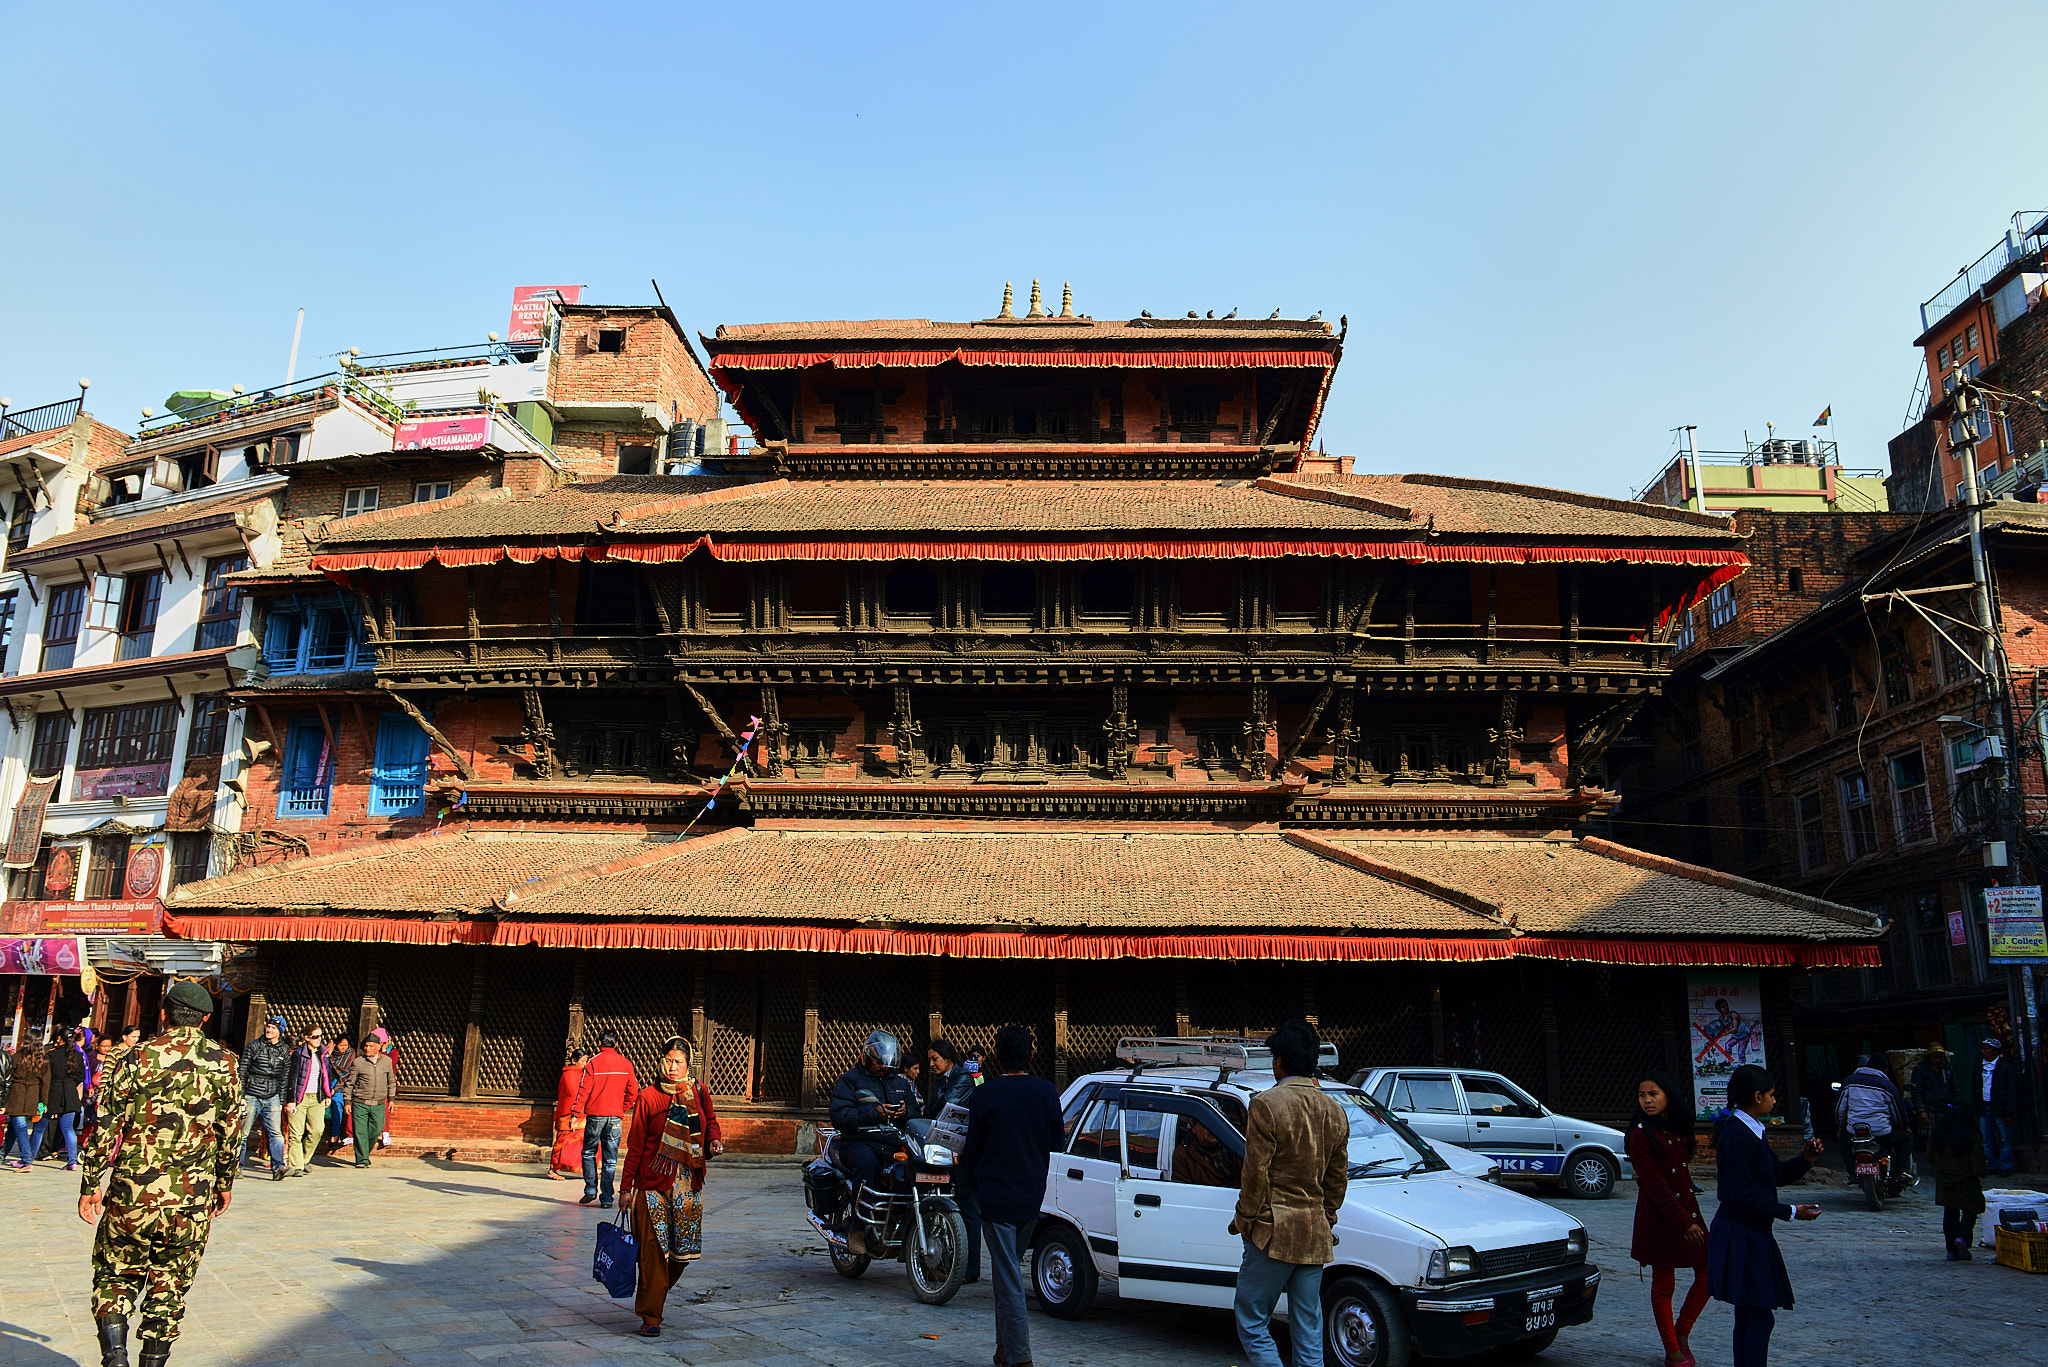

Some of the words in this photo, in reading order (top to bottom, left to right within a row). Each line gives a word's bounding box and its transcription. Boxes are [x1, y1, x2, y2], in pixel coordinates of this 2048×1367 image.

[513, 303, 545, 311] KASTHA
[422, 433, 484, 447] KASTHAMANDAP
[116, 773, 133, 782] TRIBAL
[135, 772, 156, 780] CRAFTS
[67, 902, 90, 911] Buddhist
[112, 902, 134, 912] Painting
[135, 901, 154, 911] School
[1987, 897, 2001, 914] +2
[1991, 937, 2009, 945] R.J.
[2011, 937, 2044, 947] College
